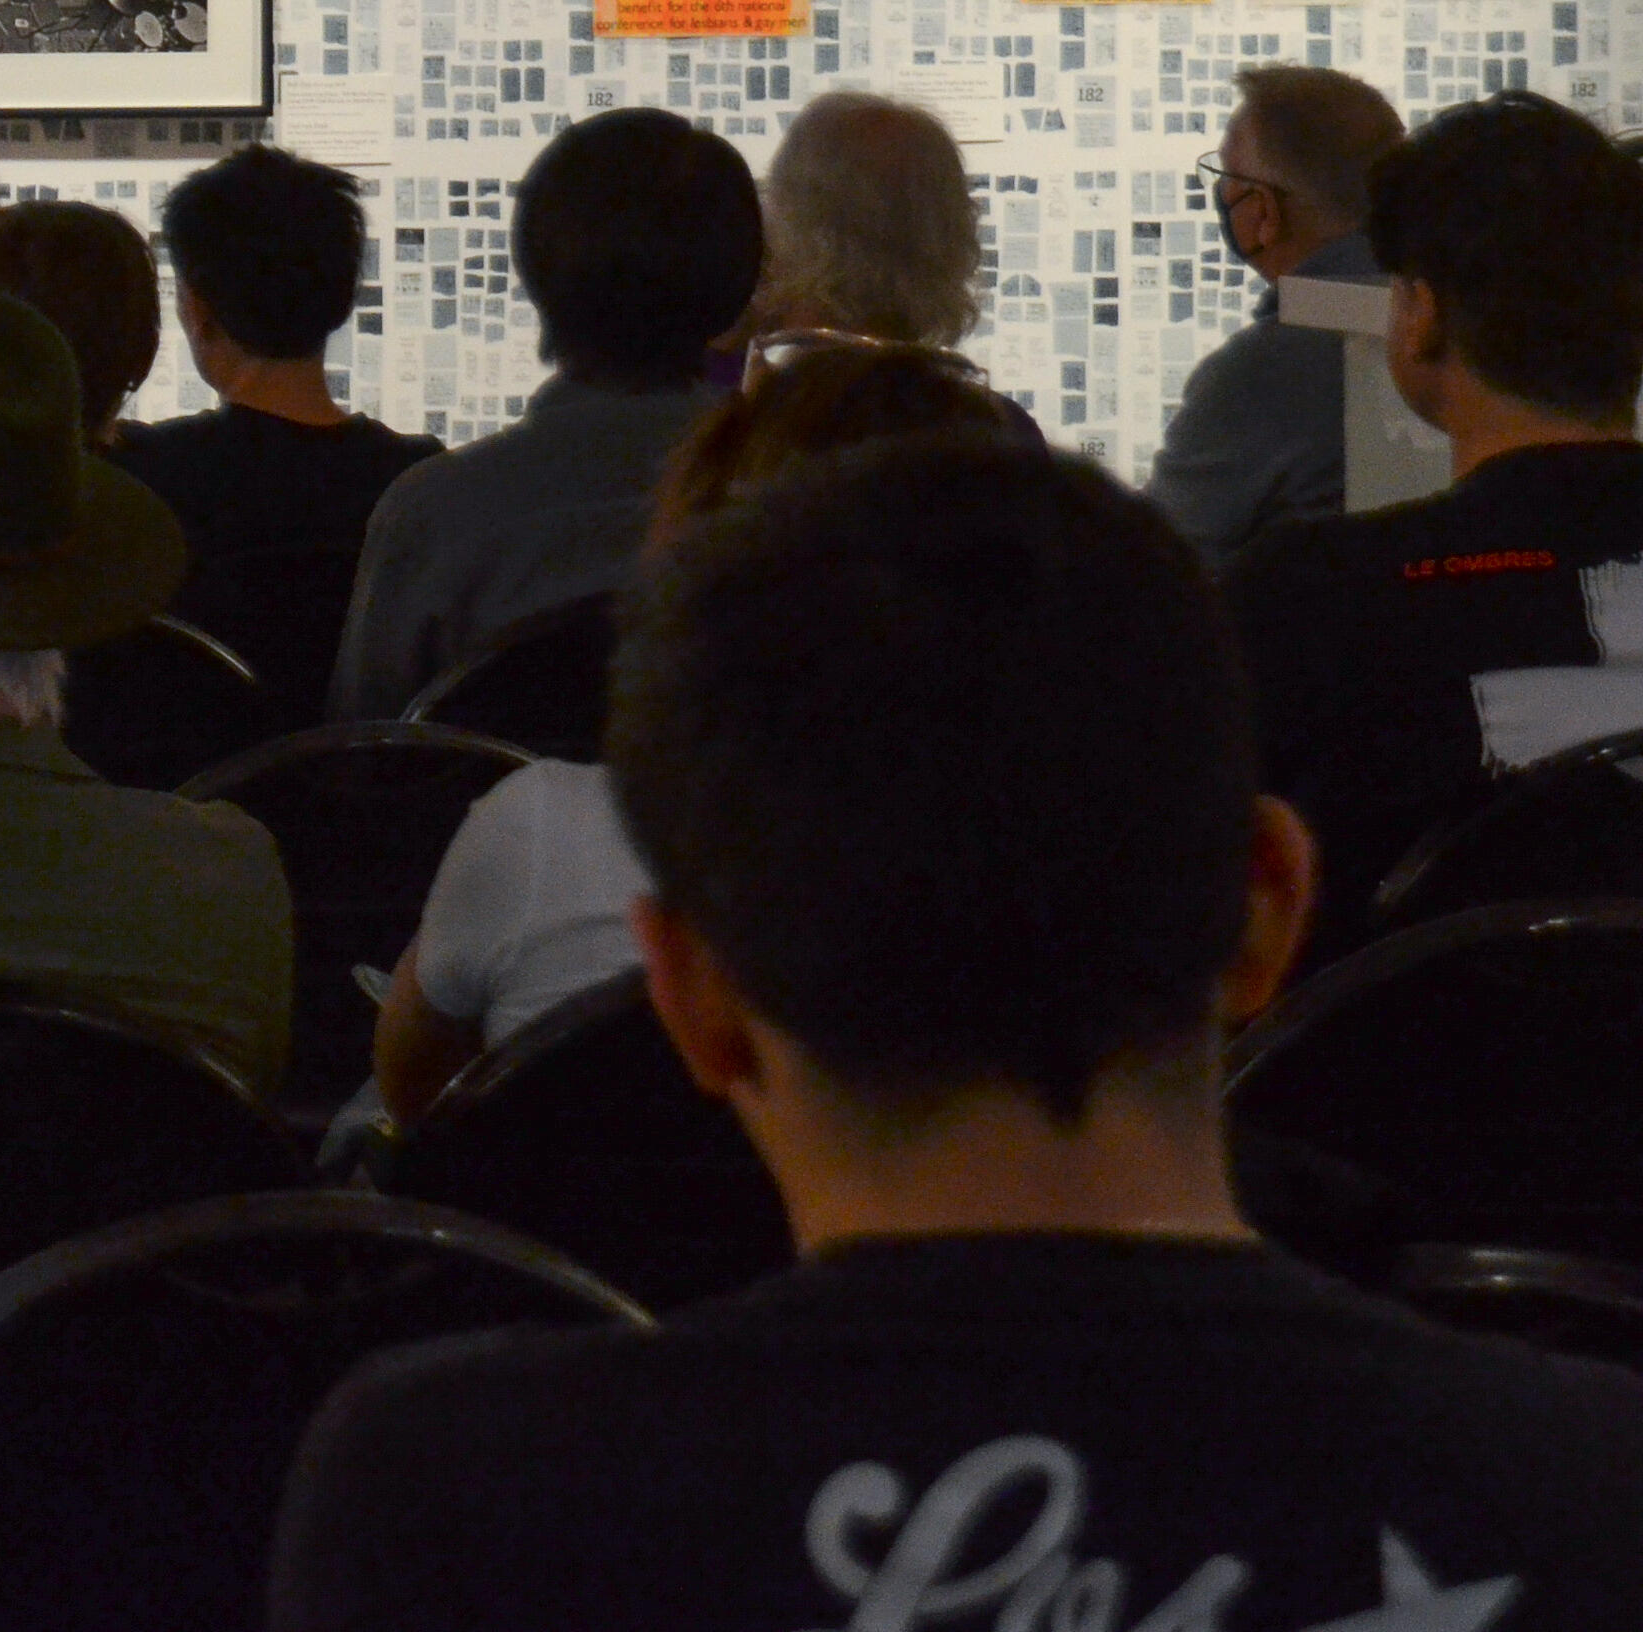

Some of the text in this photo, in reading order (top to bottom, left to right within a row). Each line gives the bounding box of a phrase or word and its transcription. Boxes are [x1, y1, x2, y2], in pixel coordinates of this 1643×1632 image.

[667, 0, 684, 12] for
[690, 0, 709, 12] the
[596, 19, 663, 32] conference
[670, 17, 686, 29] for
[1077, 87, 1105, 103] 182
[1571, 83, 1599, 99] 182
[587, 92, 615, 107] 182
[1079, 441, 1107, 456] 182
